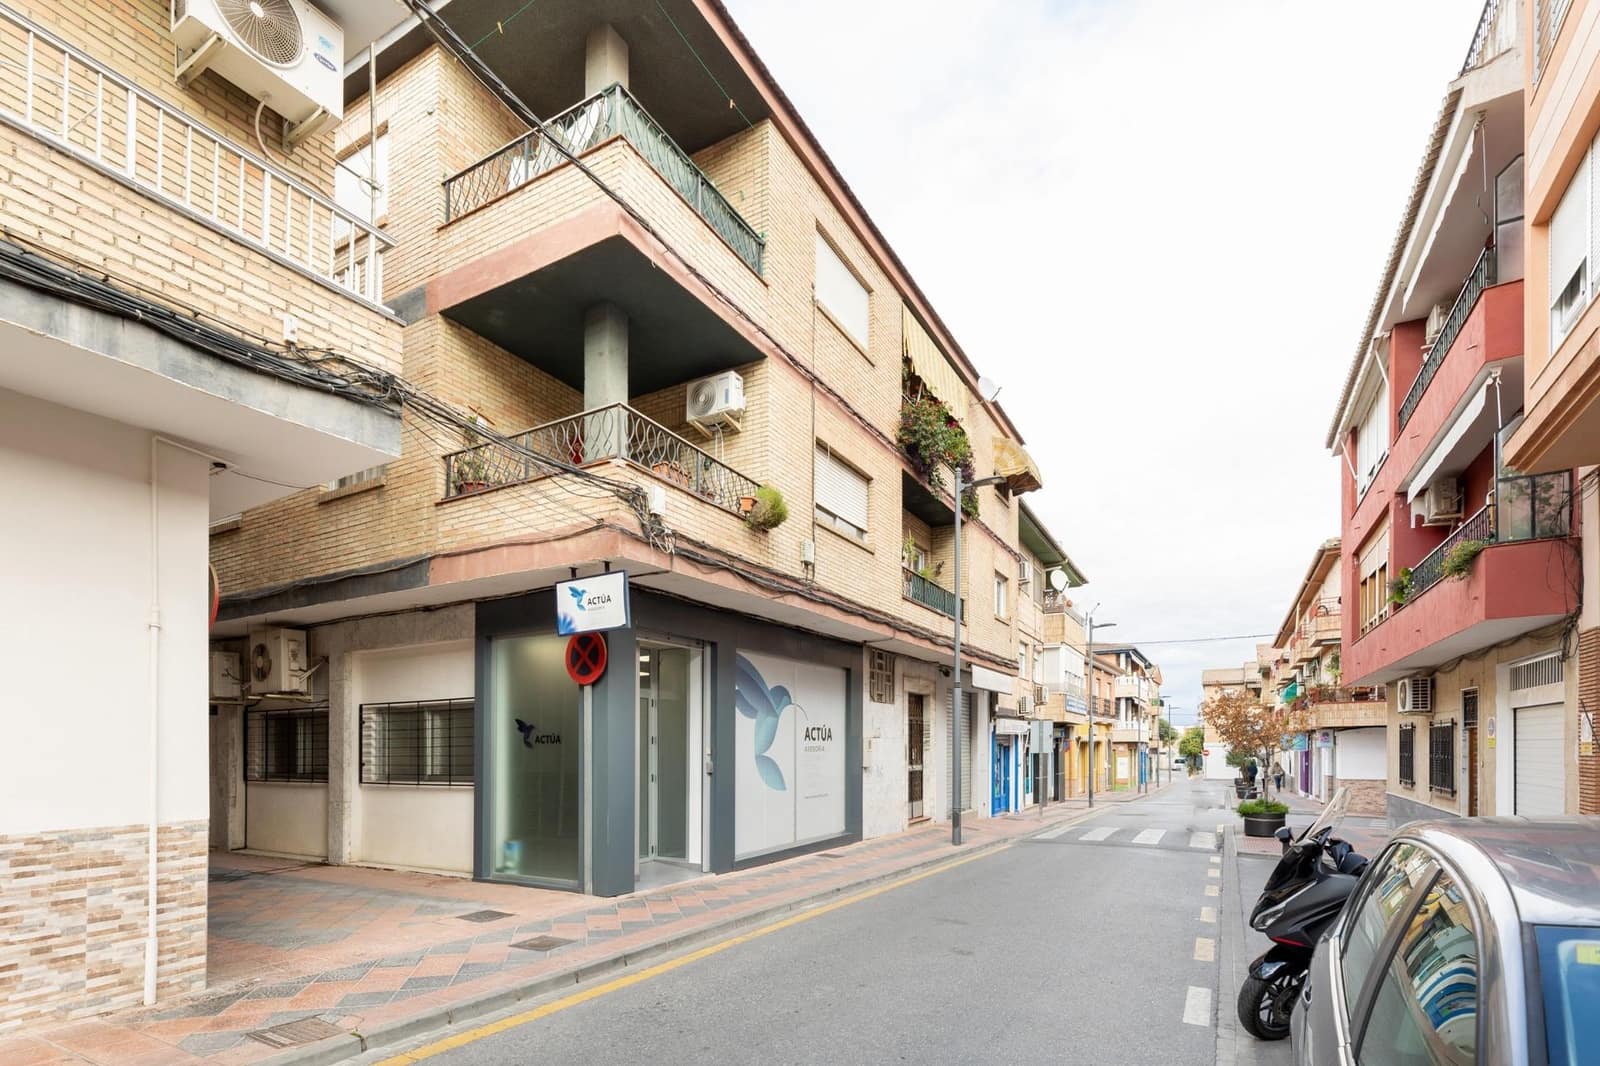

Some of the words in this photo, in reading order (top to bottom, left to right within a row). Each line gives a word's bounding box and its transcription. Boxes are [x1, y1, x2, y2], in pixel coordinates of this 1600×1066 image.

[587, 594, 612, 606] ACTÚA
[534, 732, 561, 744] ACTÚA
[804, 724, 832, 741] ACTÚA
